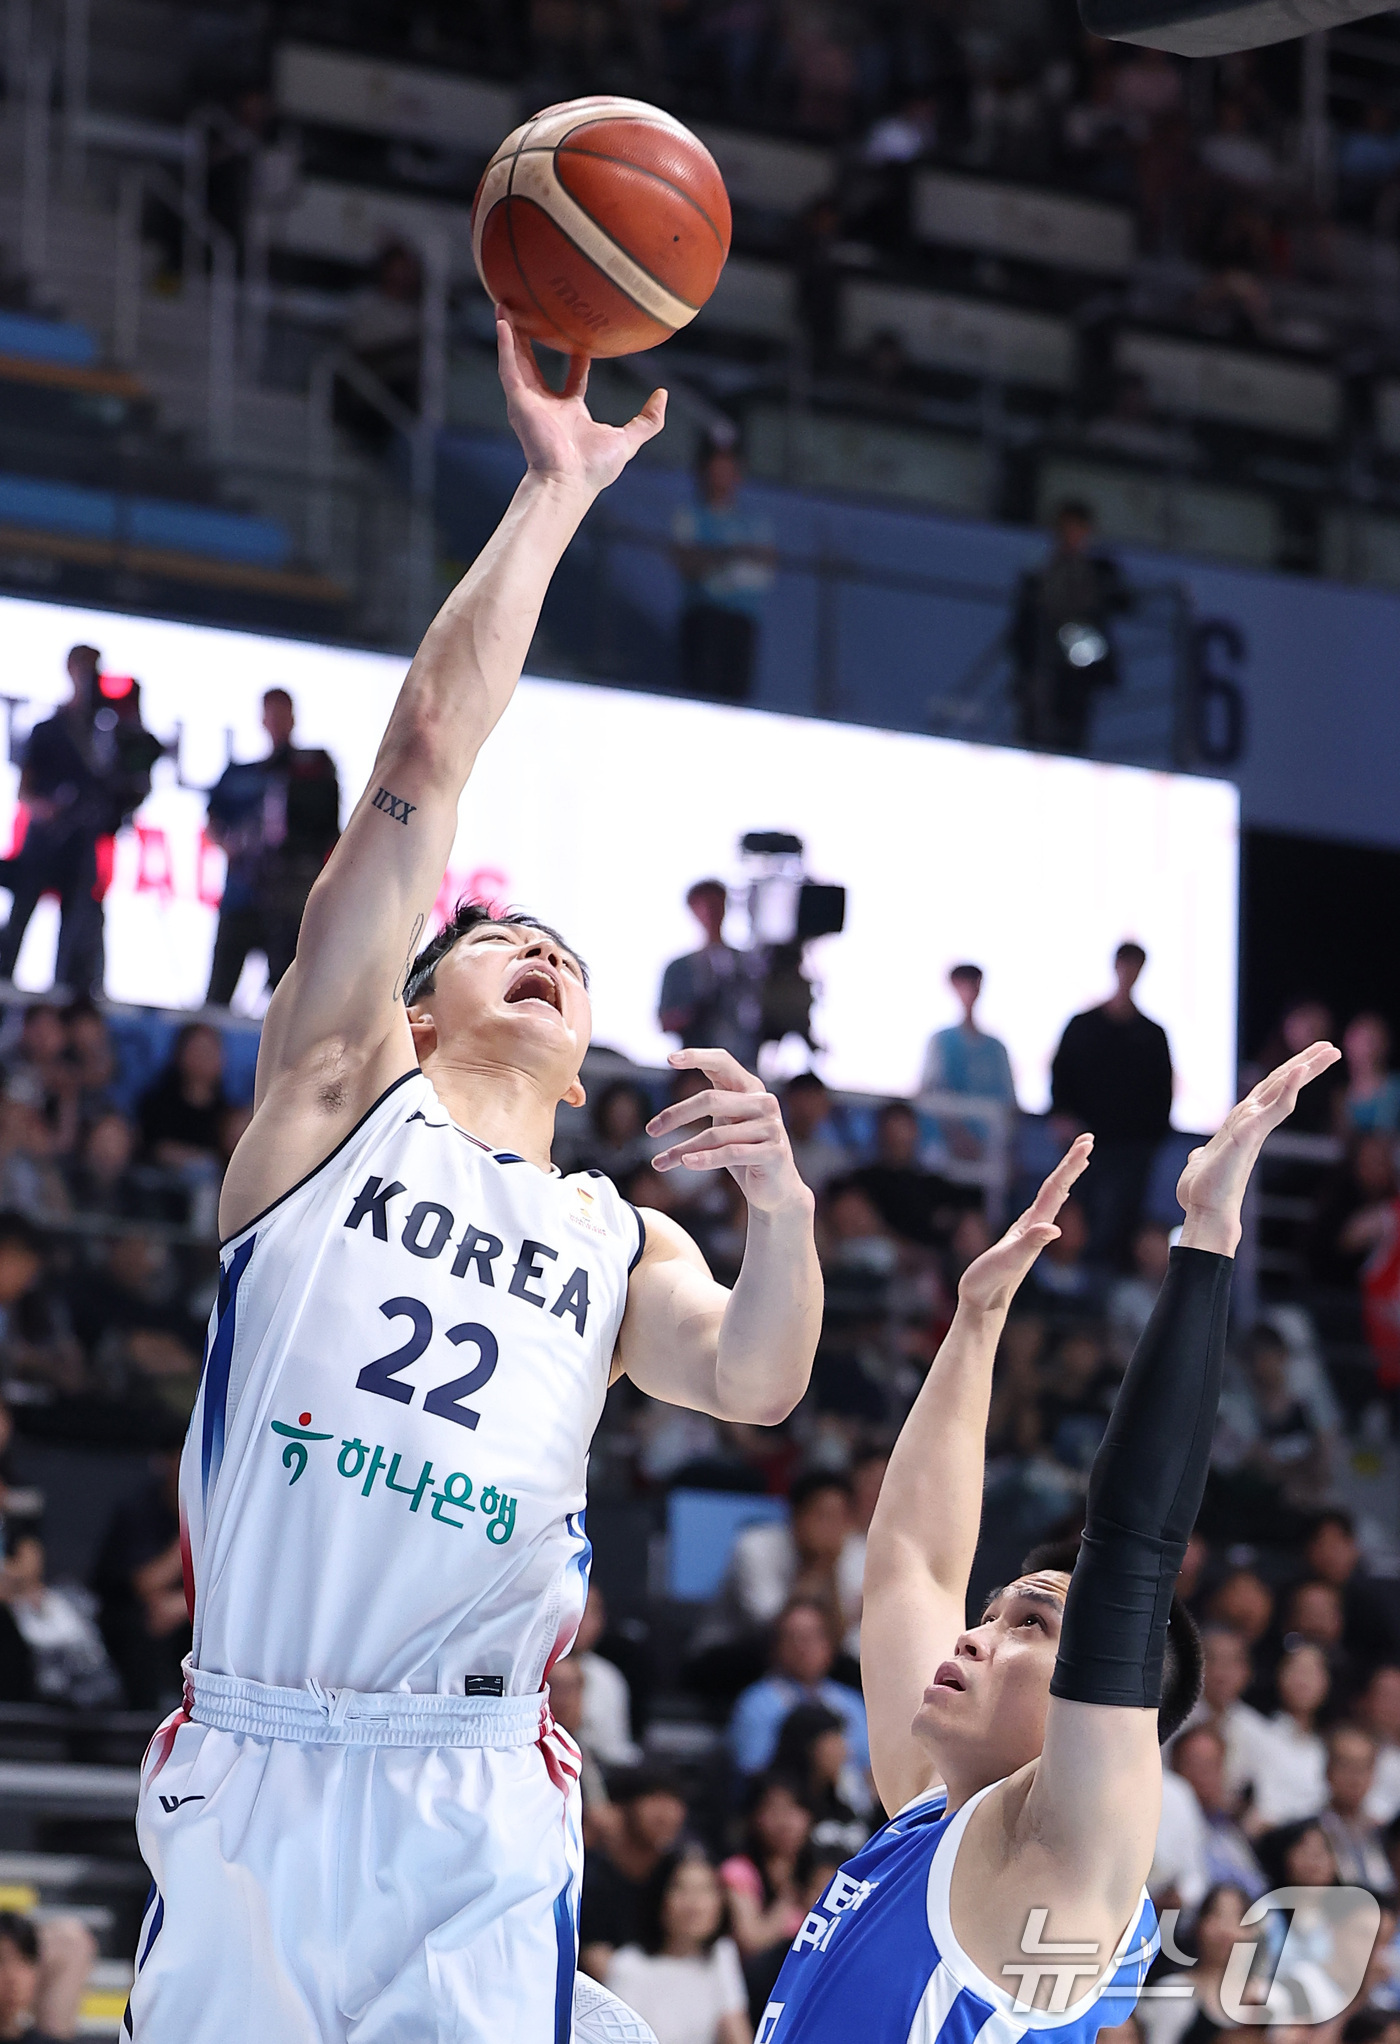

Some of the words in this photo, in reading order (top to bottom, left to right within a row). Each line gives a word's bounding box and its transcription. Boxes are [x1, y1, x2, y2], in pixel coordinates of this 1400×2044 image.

[1194, 617, 1245, 768] 6
[343, 1175, 591, 1338] KOREA
[355, 1296, 499, 1431] 22
[336, 1437, 518, 1545] 하나은행
